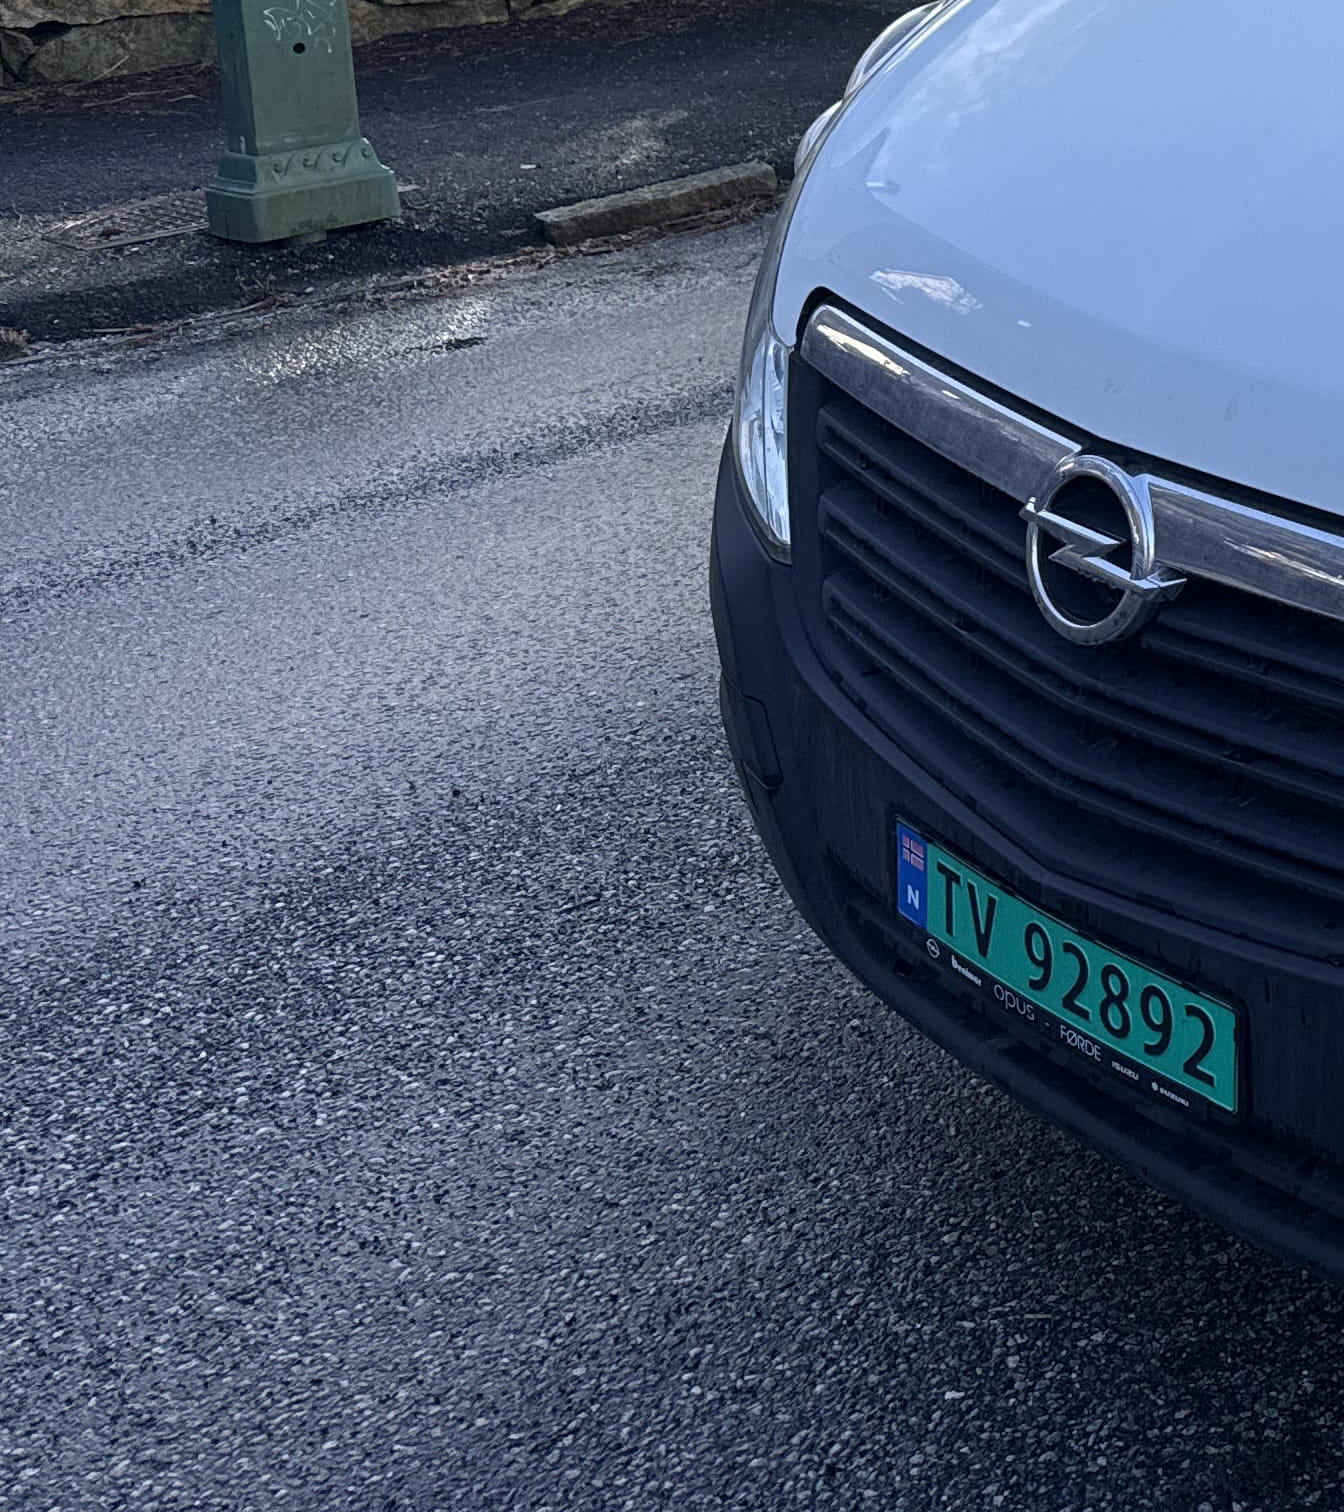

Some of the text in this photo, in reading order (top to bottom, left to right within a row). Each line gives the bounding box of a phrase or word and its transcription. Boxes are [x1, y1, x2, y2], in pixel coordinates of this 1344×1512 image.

[906, 884, 920, 911] N
[937, 860, 1217, 1088] TV 92892
[993, 984, 1036, 1021] opus
[1060, 1024, 1102, 1062] FØRDE
